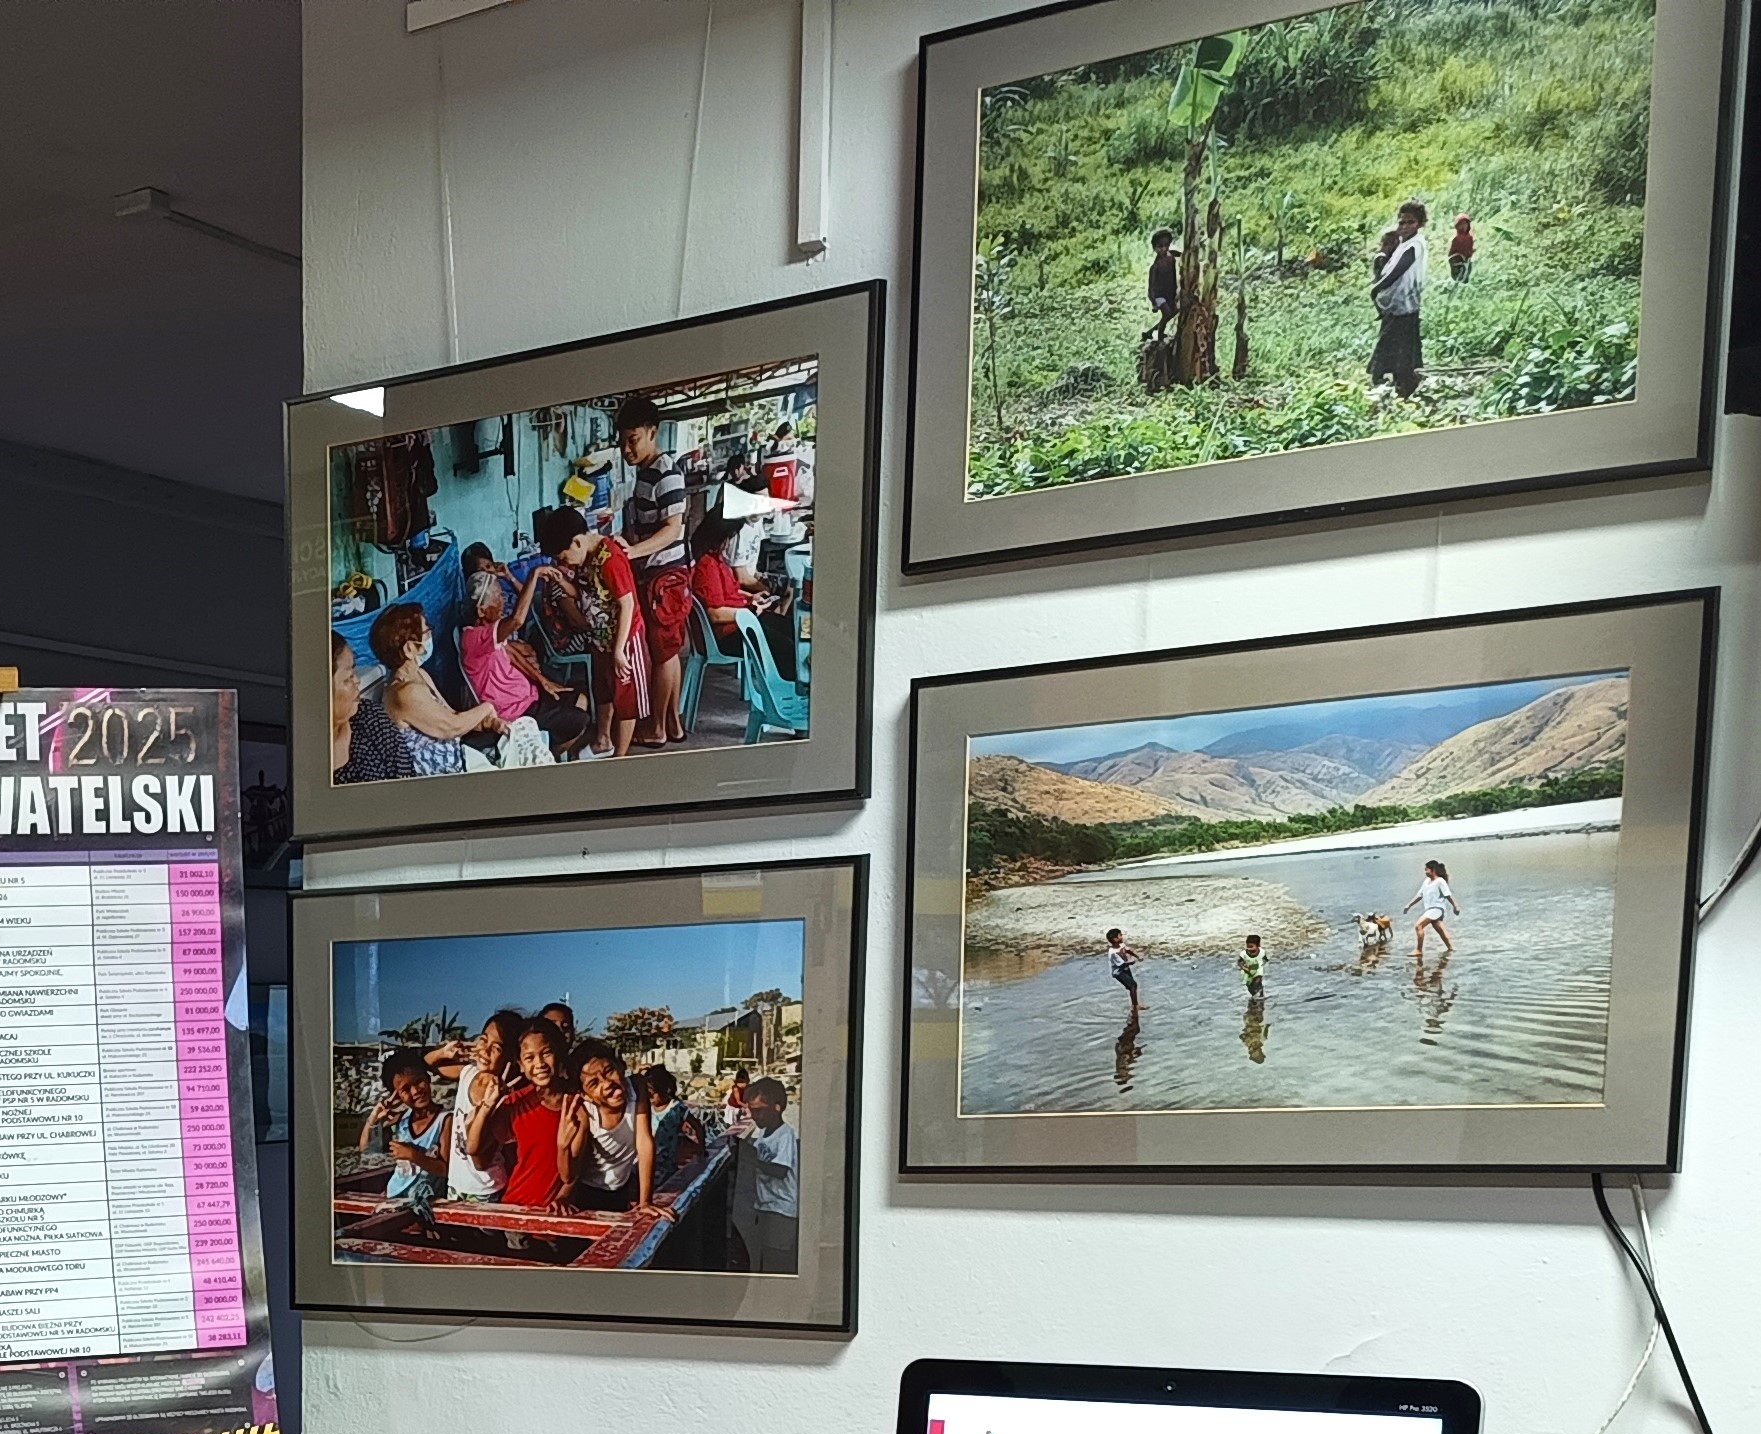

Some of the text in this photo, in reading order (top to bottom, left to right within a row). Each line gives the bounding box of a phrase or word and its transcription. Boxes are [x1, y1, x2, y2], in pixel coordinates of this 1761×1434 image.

[66, 706, 195, 766] 2025
[7, 877, 18, 885] NR
[58, 1071, 95, 1079] KUKUCZKI
[17, 1132, 35, 1140] PRZY
[50, 1130, 97, 1138] CHABROWEJ
